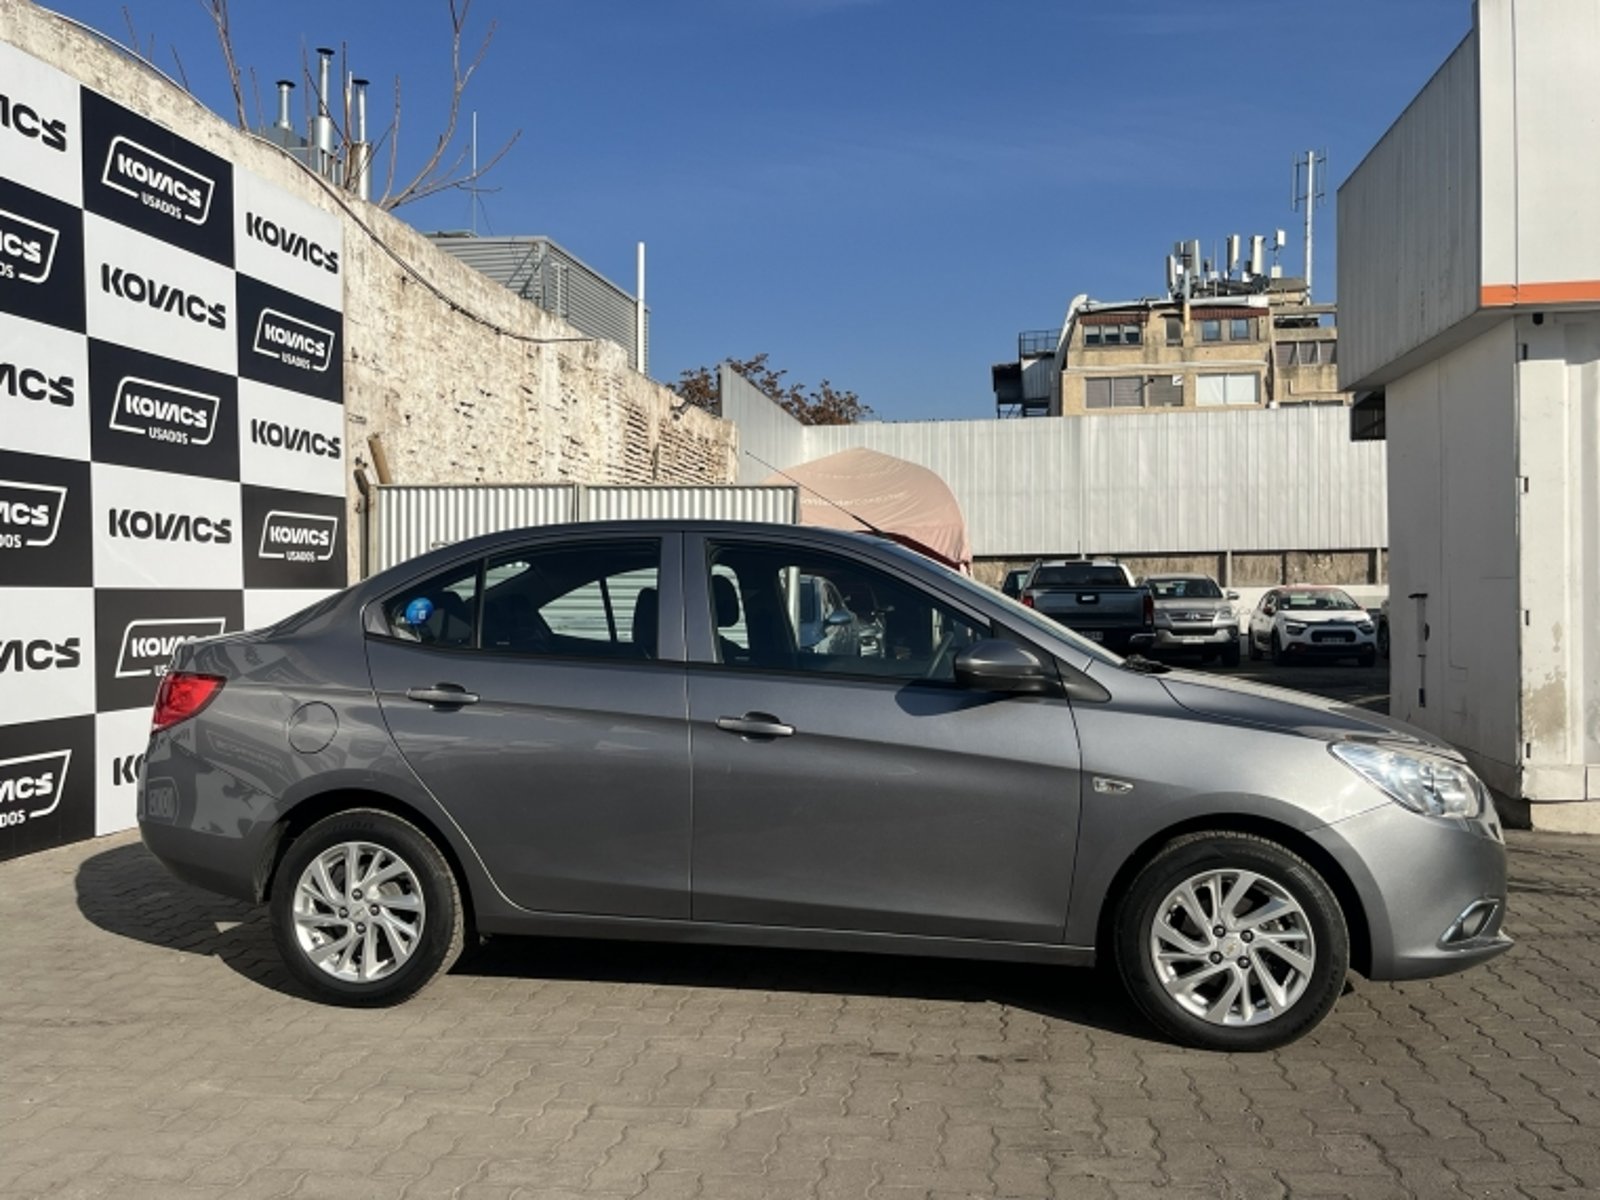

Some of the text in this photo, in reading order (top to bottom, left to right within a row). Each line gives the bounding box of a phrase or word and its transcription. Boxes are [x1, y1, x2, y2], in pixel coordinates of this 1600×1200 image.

[117, 153, 201, 207] KOVACS
[142, 192, 182, 219] USADOS
[246, 212, 338, 274] KOVACS
[101, 263, 226, 330] KOVACS
[265, 323, 325, 356] KOVACS
[282, 352, 311, 370] USADOS
[126, 394, 207, 428] KOVACS
[149, 427, 188, 444] USADOS
[251, 419, 341, 459] KOVACS
[109, 508, 231, 544] KOVACS
[270, 526, 329, 545] KOVACS
[286, 551, 315, 562] USADOS
[0, 638, 80, 673] ACS
